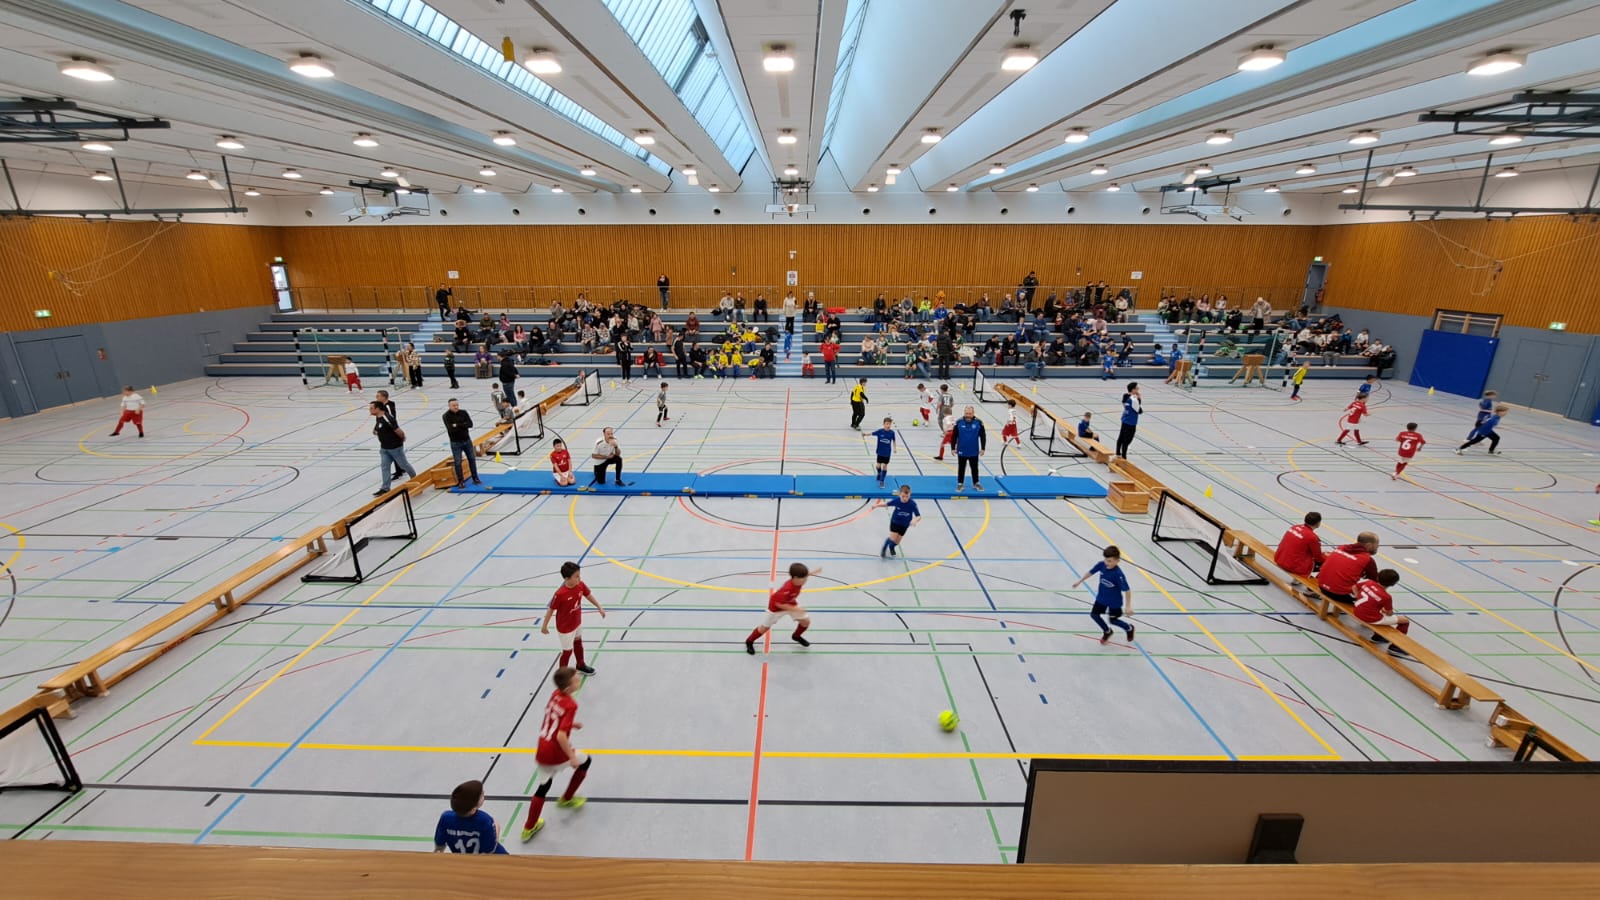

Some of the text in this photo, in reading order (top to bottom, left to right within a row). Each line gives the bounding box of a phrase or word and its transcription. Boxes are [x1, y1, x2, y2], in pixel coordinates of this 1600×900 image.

[1401, 439, 1412, 450] 6
[1354, 590, 1369, 607] 7
[454, 838, 480, 854] 12
